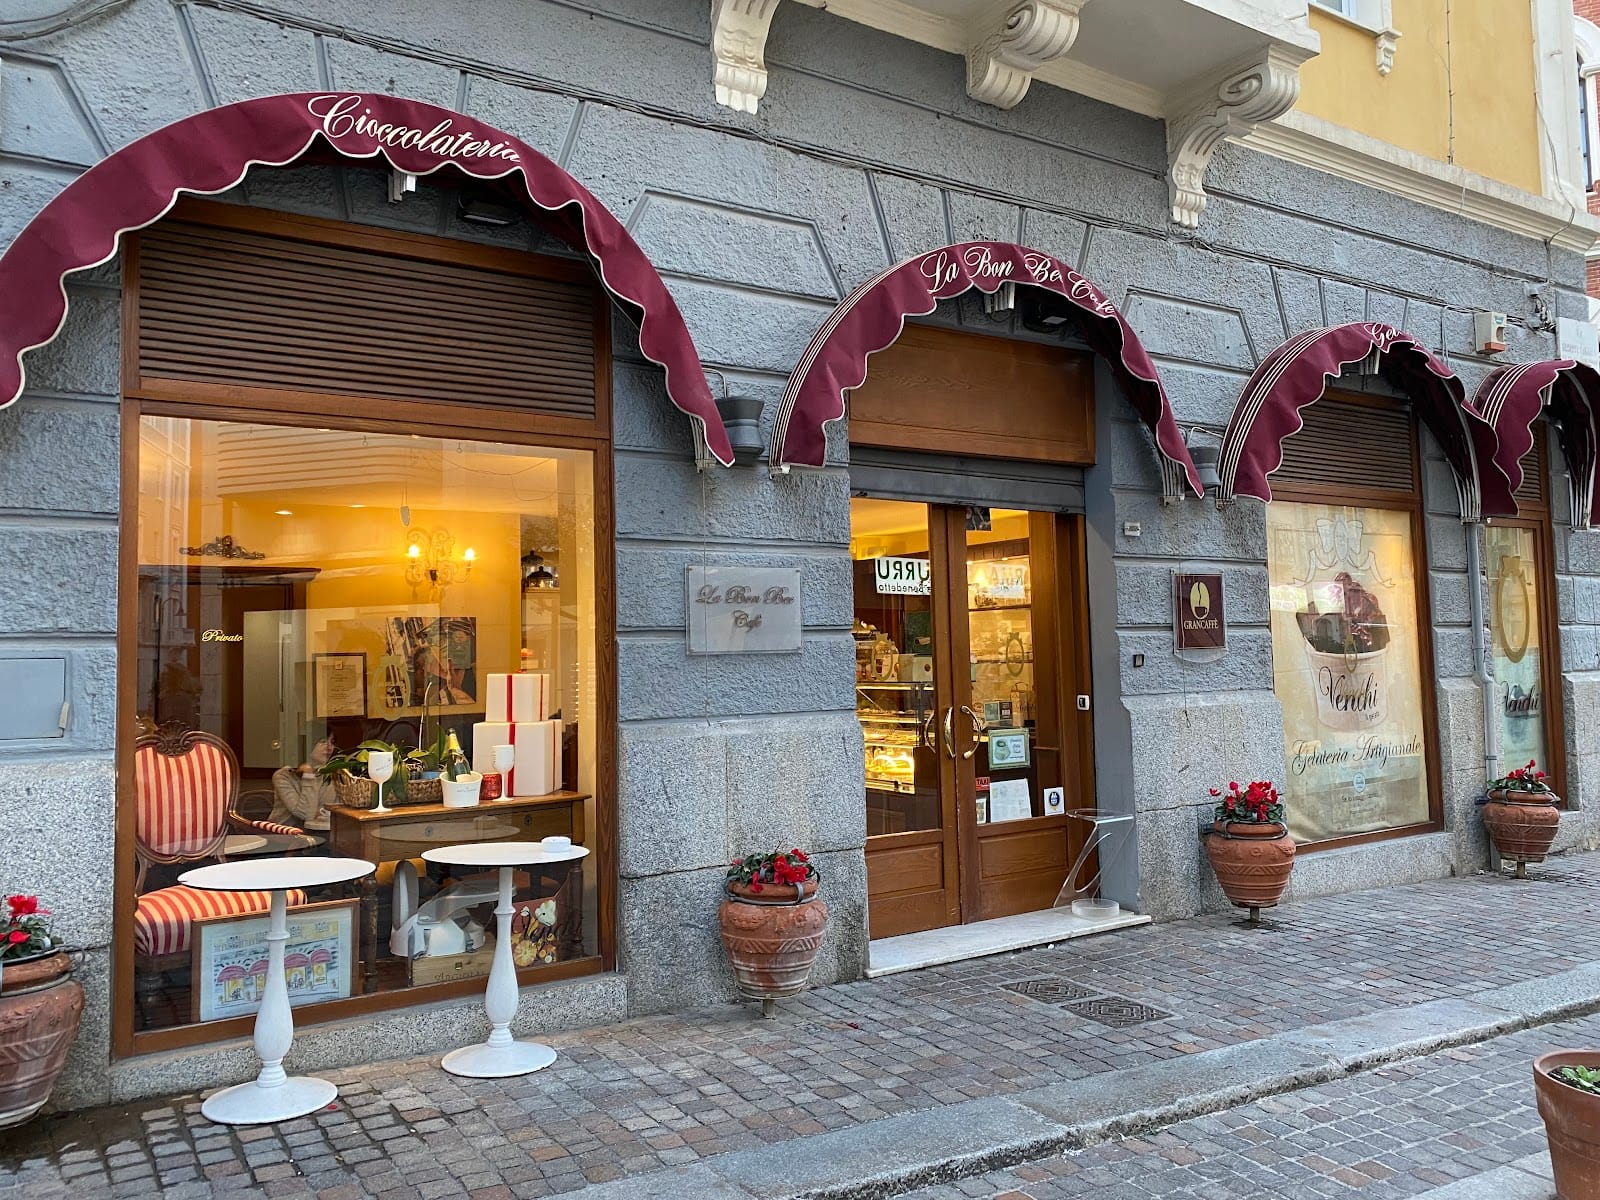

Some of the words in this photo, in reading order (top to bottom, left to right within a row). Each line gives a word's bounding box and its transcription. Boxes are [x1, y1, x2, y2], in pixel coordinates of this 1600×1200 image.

[307, 95, 521, 162] Cioccolateria
[920, 251, 960, 293] La
[963, 246, 1014, 278] Bon
[201, 629, 243, 642] Privato
[1318, 665, 1379, 713] Venchi
[1291, 739, 1349, 776] Gelateria
[1352, 734, 1421, 769] Artigianale
